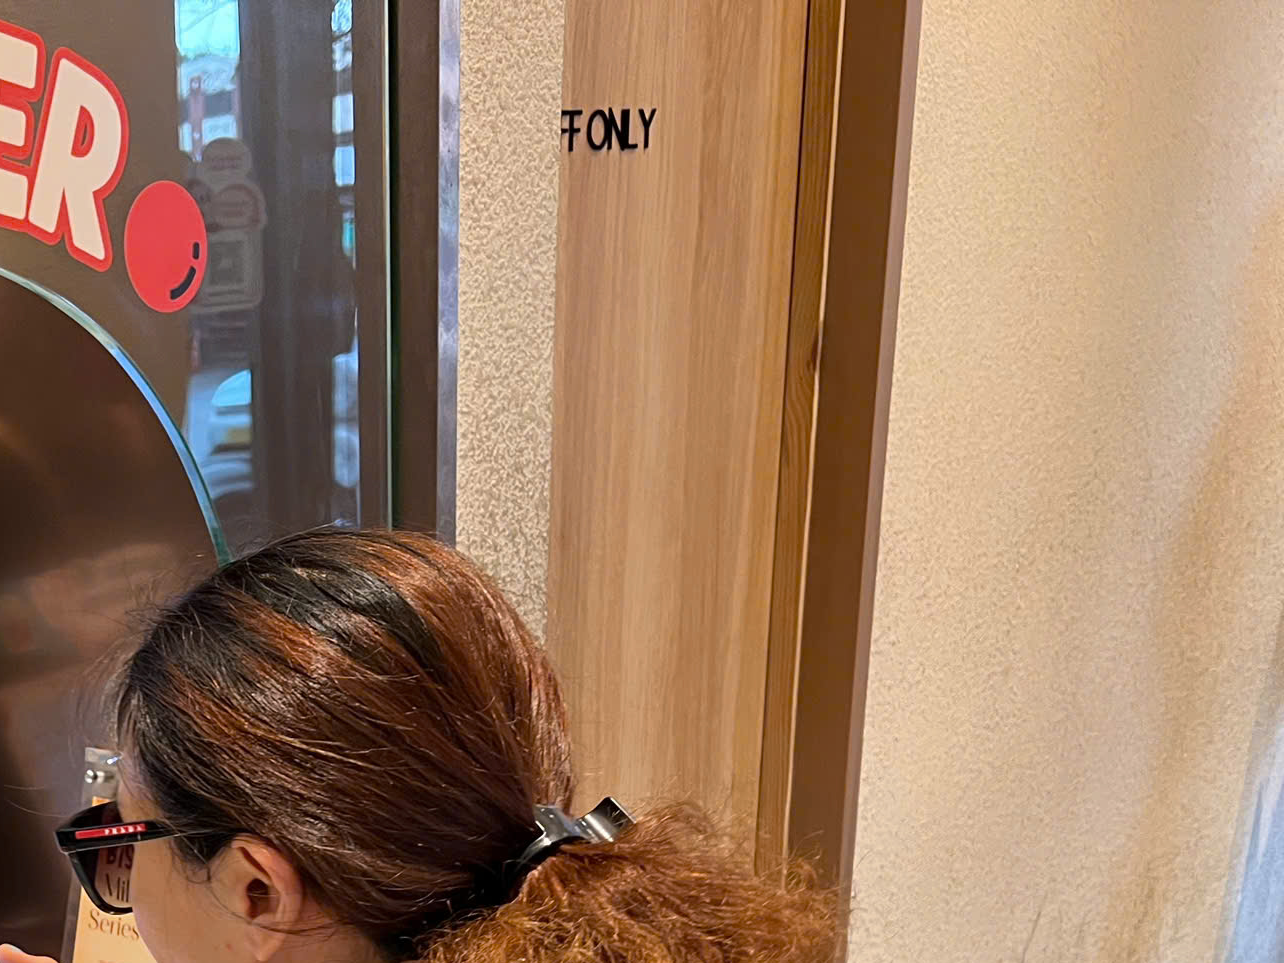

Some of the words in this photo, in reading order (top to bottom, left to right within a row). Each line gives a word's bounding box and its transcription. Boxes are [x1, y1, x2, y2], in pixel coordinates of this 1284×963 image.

[586, 107, 657, 151] ONLY
[103, 824, 144, 837] PRADA
[88, 908, 140, 943] Series
